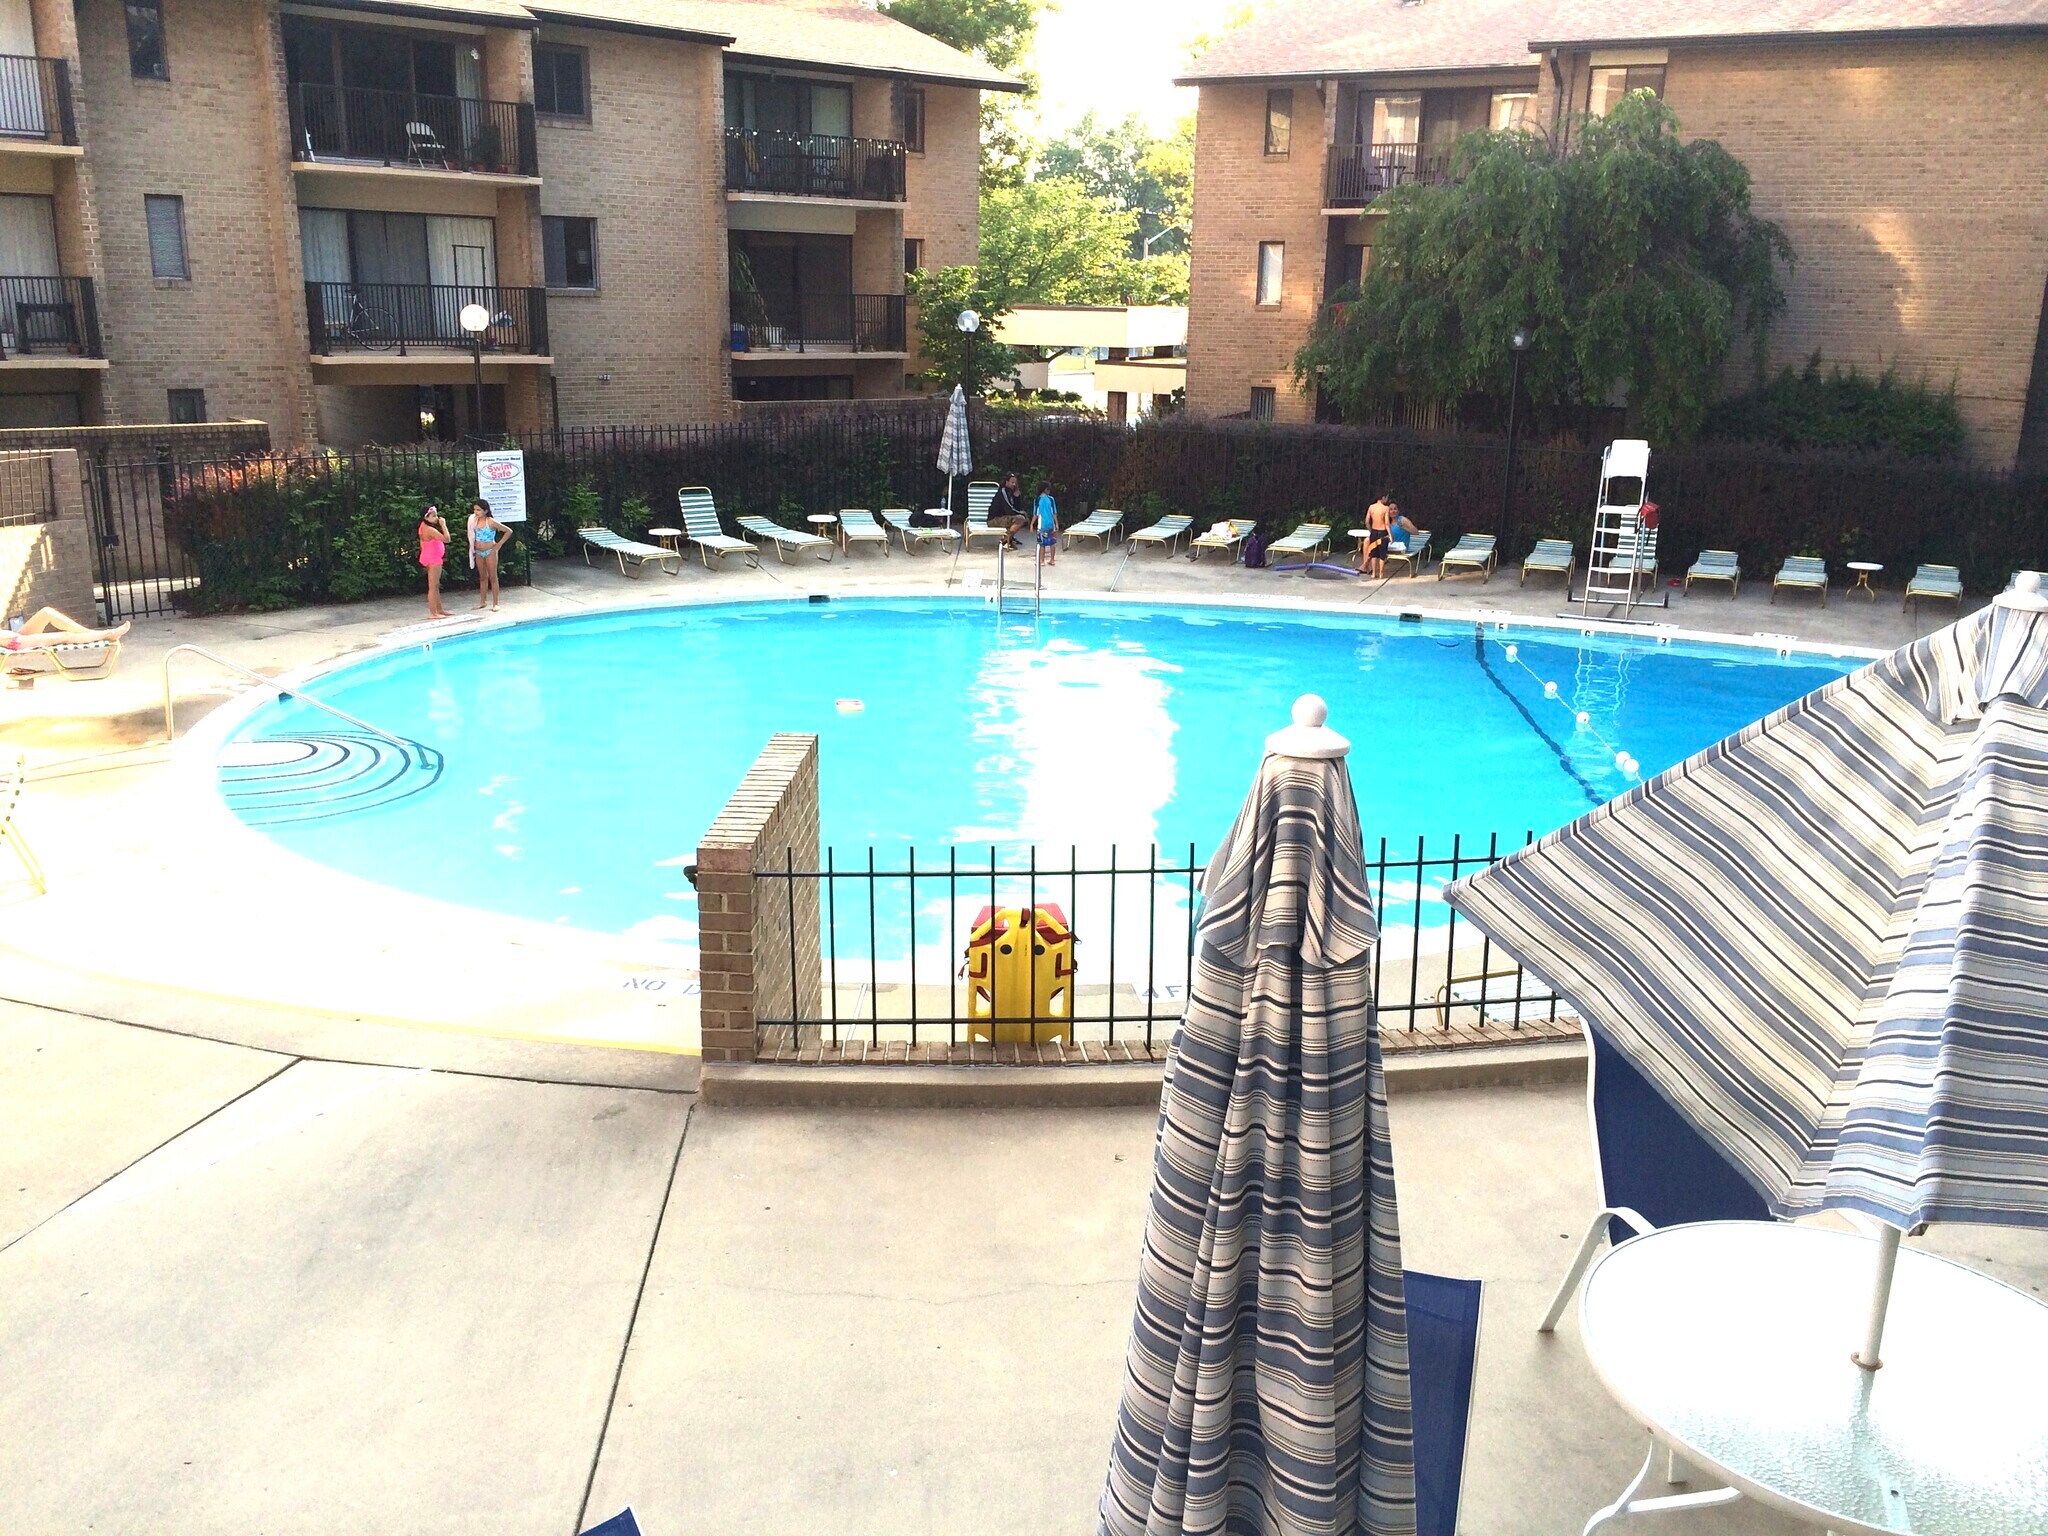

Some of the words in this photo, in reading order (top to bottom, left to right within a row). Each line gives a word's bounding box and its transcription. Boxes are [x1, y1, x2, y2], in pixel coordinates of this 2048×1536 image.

[487, 463, 512, 472] Swim
[491, 470, 511, 479] Safe
[623, 978, 666, 990] NO
